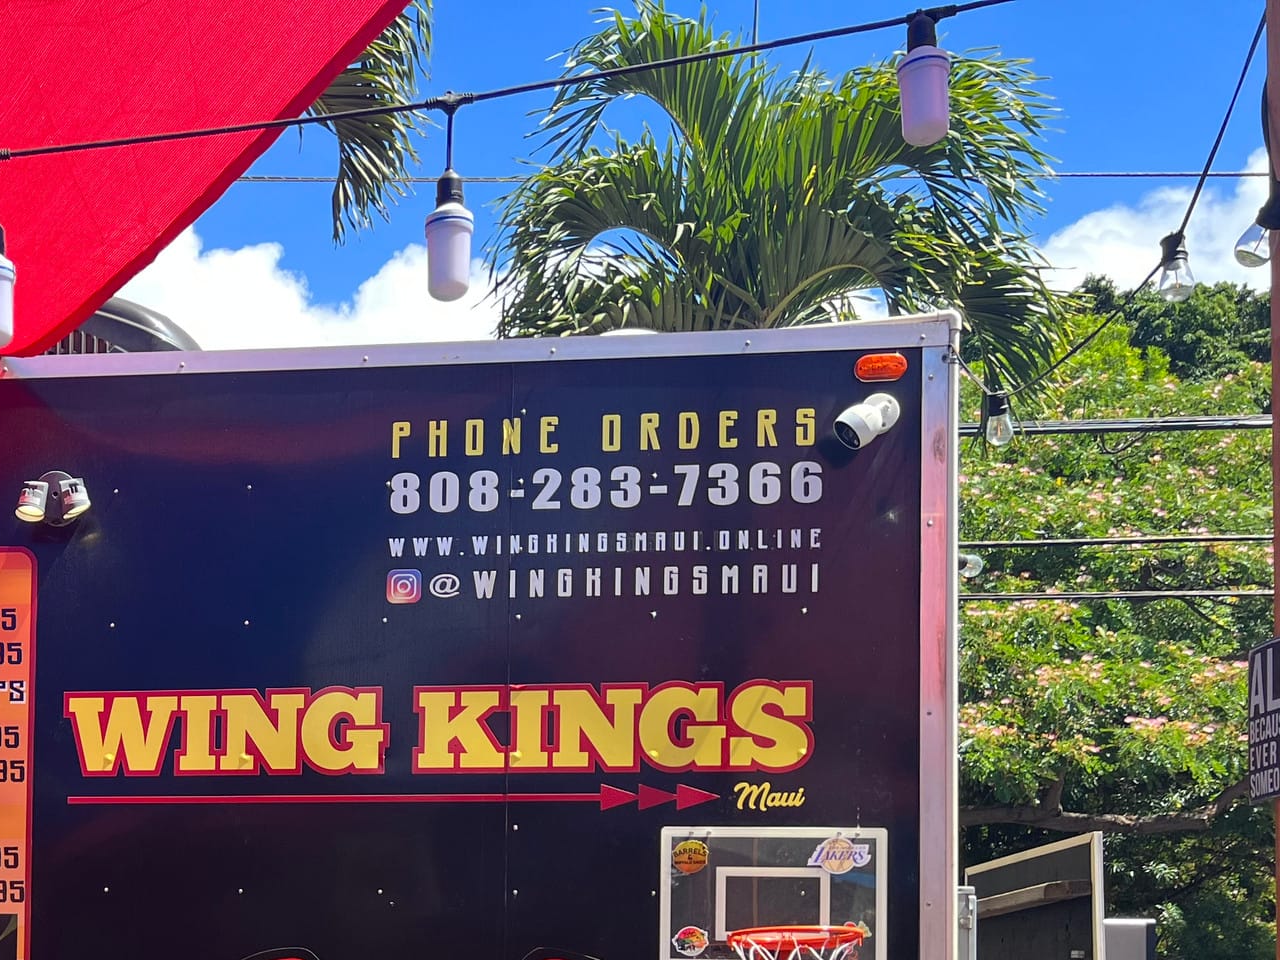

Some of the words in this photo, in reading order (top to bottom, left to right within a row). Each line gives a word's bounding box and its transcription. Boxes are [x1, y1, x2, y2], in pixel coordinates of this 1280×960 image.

[391, 415, 560, 460] PHONE
[601, 408, 817, 453] ORDERS
[390, 461, 823, 515] 808-283-7366
[64, 686, 391, 777] WING
[412, 679, 814, 775] KINGS
[1250, 741, 1277, 771] EVER
[732, 782, 807, 812] Maui
[813, 846, 865, 865] LAKERS
